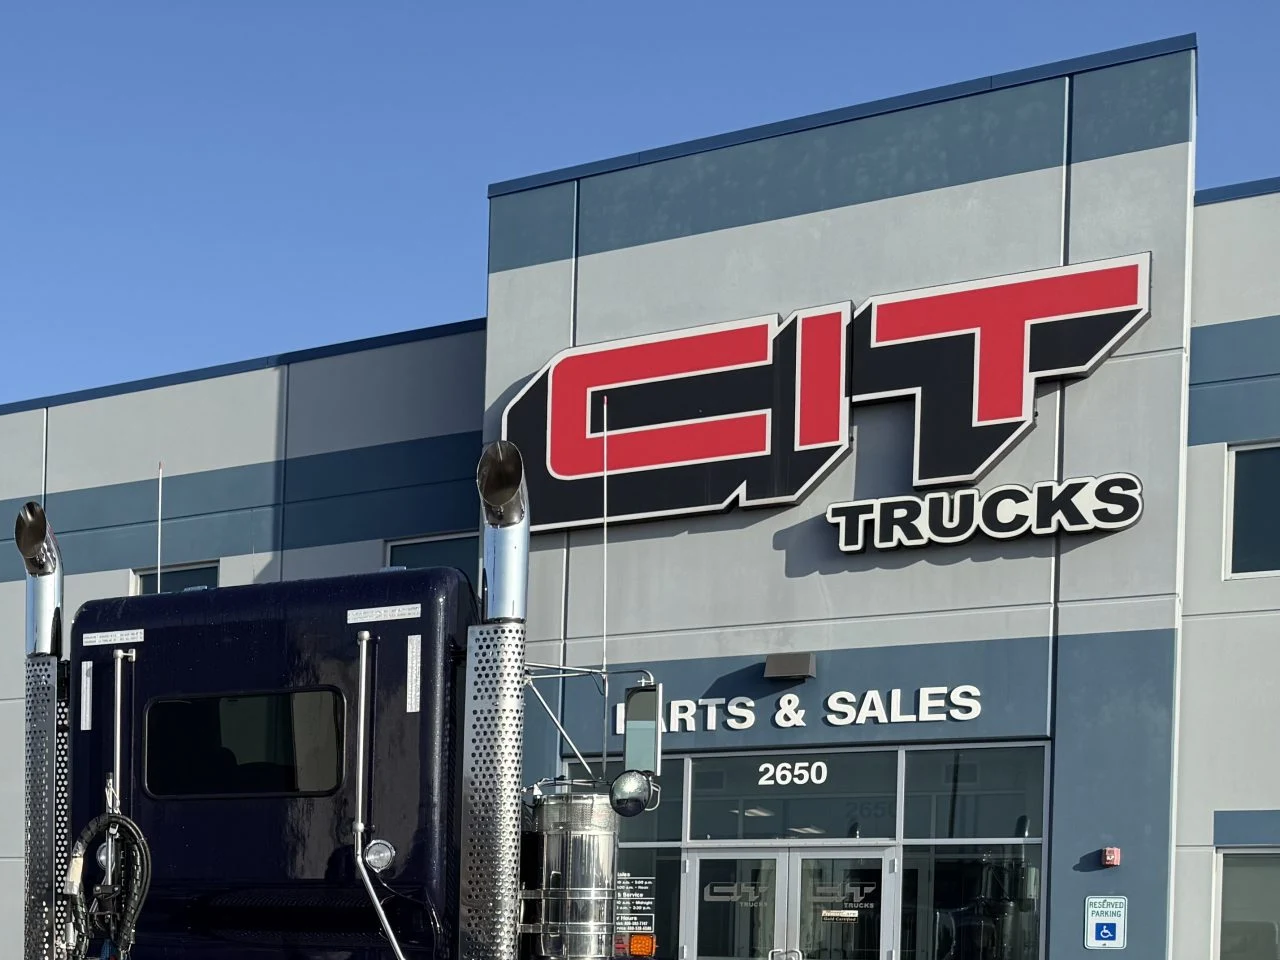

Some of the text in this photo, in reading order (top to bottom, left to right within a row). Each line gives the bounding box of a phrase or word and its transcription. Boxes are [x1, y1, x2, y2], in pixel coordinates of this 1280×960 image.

[510, 254, 1150, 526] CIT
[828, 475, 1141, 551] TRUCKS
[616, 685, 982, 734] RTS & SALES
[758, 761, 828, 785] 2650
[1089, 901, 1124, 909] RESERVED
[1091, 910, 1122, 918] PARKING
